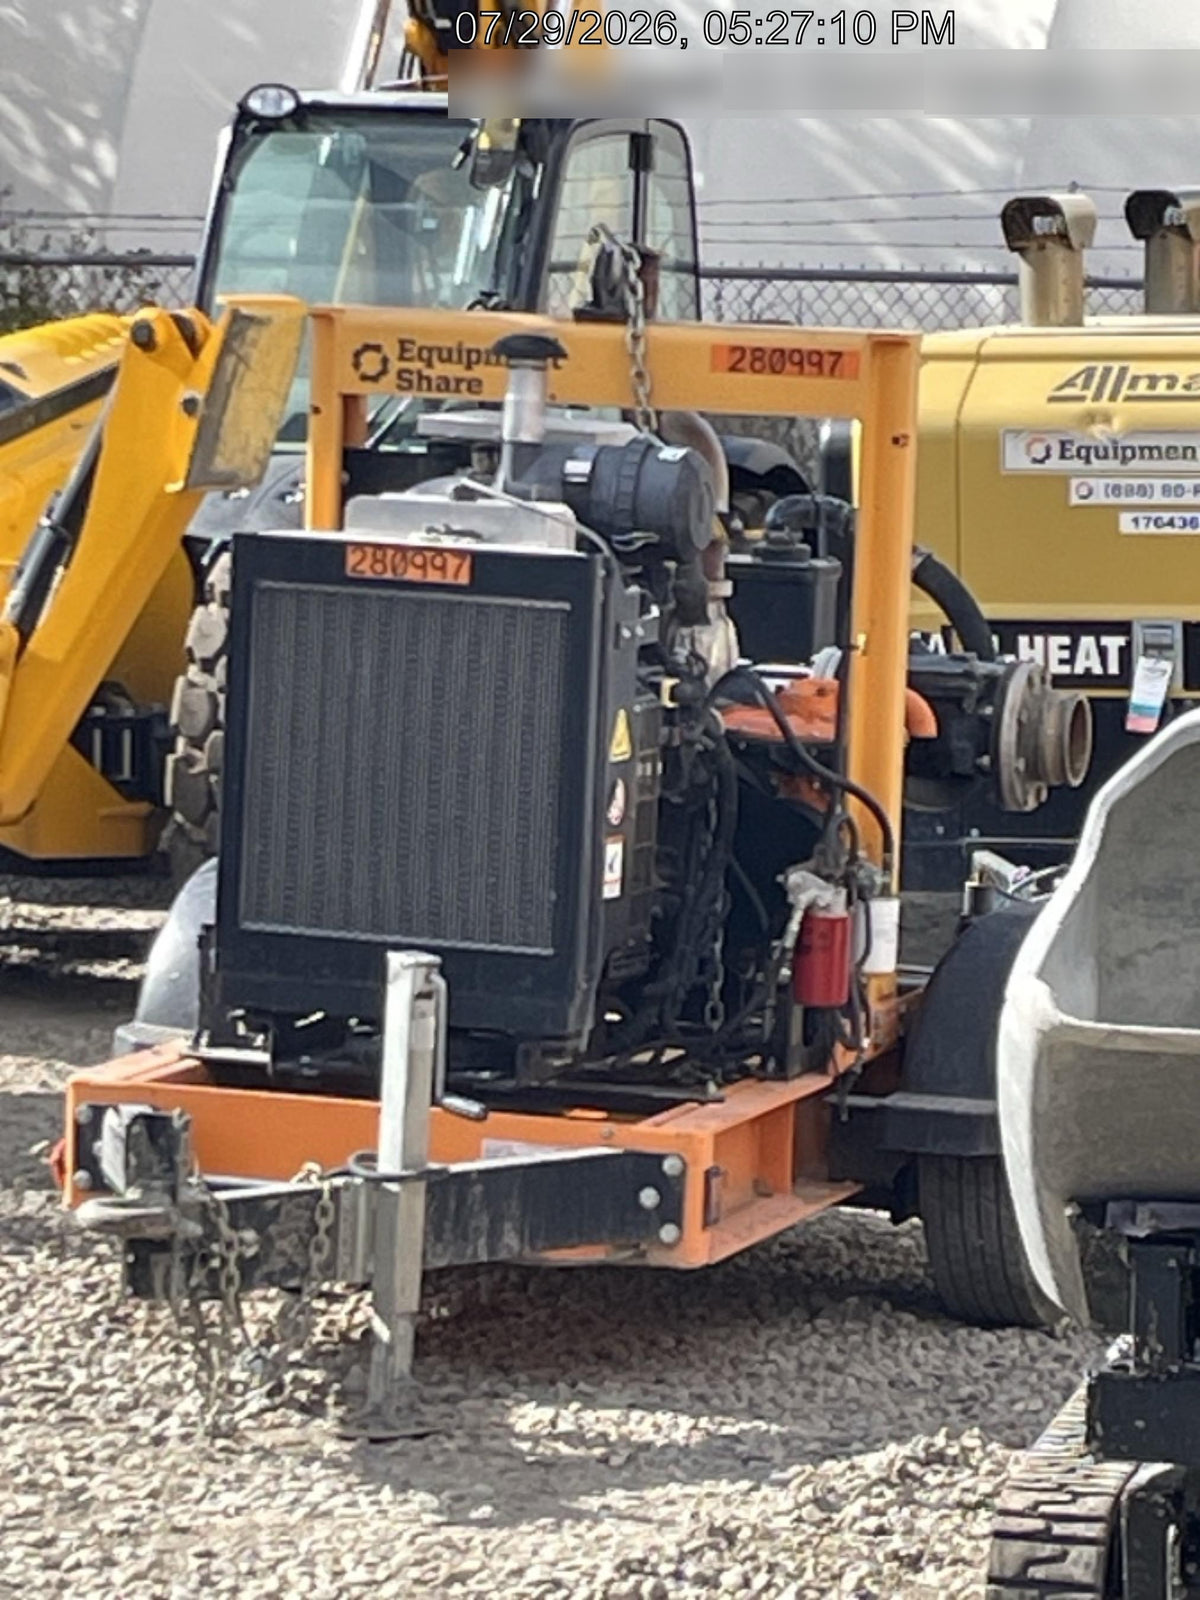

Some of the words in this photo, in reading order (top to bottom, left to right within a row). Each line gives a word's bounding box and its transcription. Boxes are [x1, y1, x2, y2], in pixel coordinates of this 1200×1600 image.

[728, 346, 843, 376] 280997
[396, 368, 484, 394] Share
[349, 546, 468, 582] 280997
